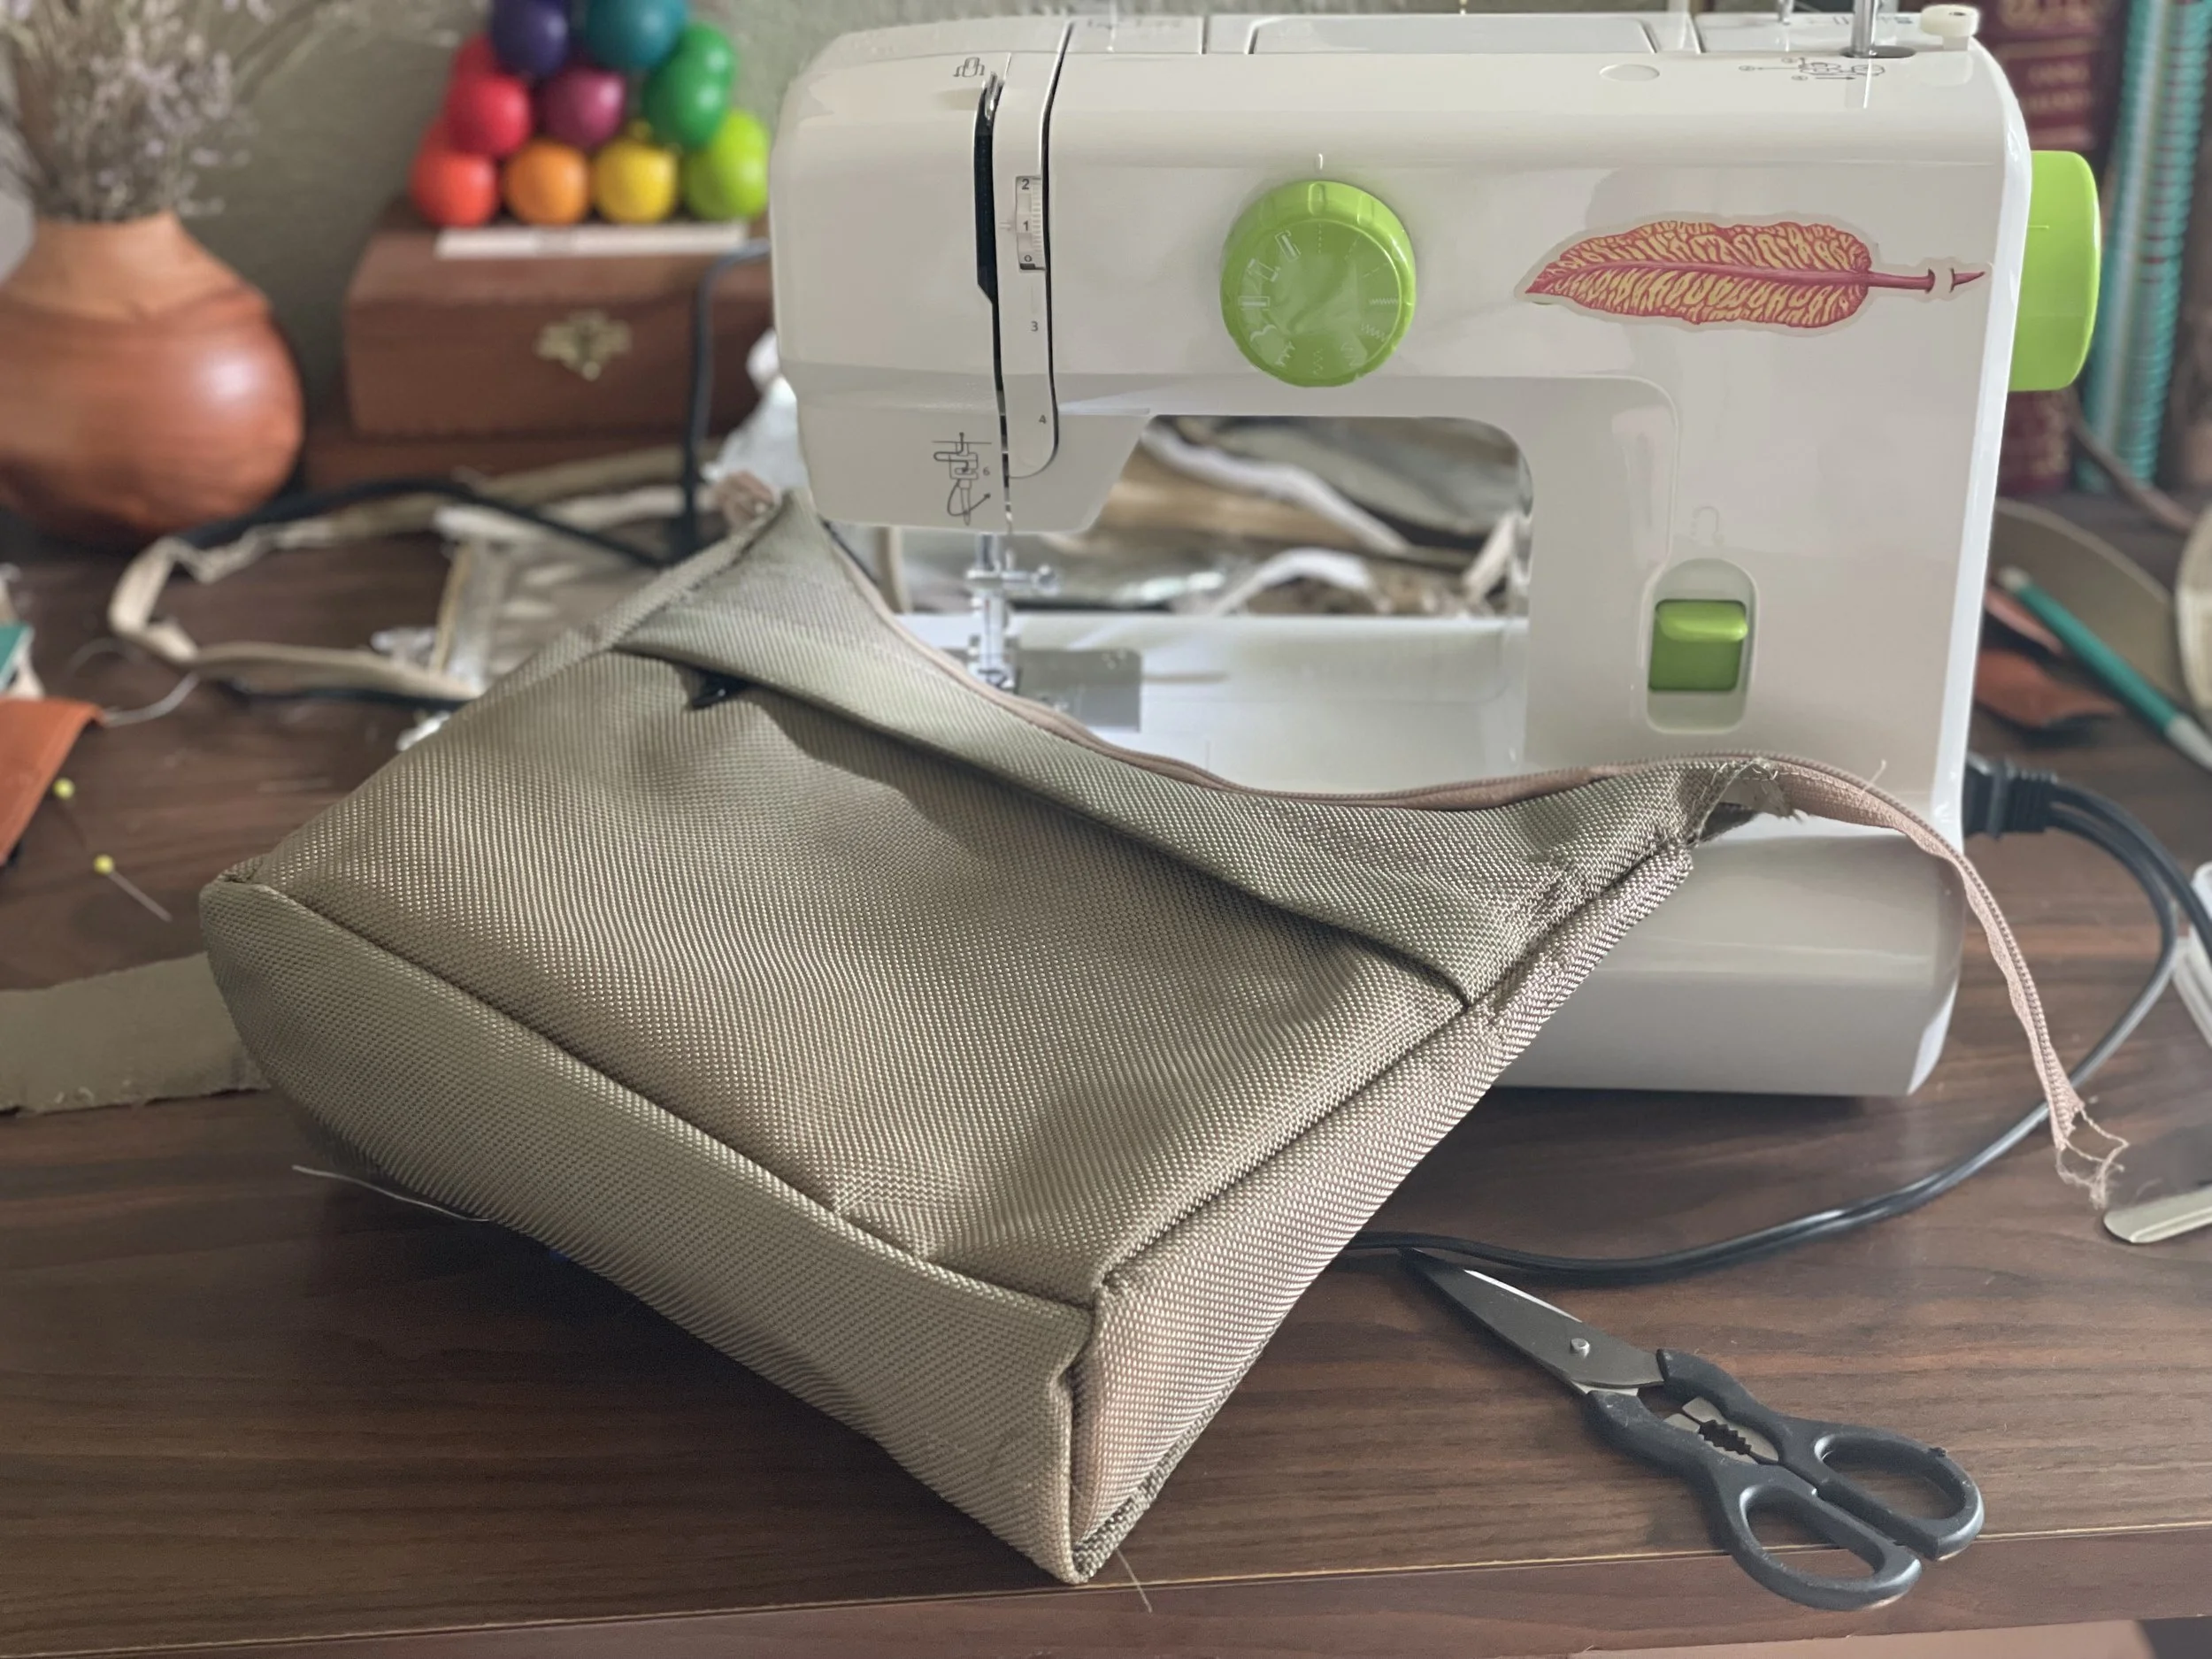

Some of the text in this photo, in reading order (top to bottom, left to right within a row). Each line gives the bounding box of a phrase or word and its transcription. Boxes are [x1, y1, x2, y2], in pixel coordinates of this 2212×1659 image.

[1021, 178, 1030, 190] 2
[1023, 220, 1029, 231] 1
[1031, 320, 1039, 332] 3
[1038, 414, 1047, 424] 4
